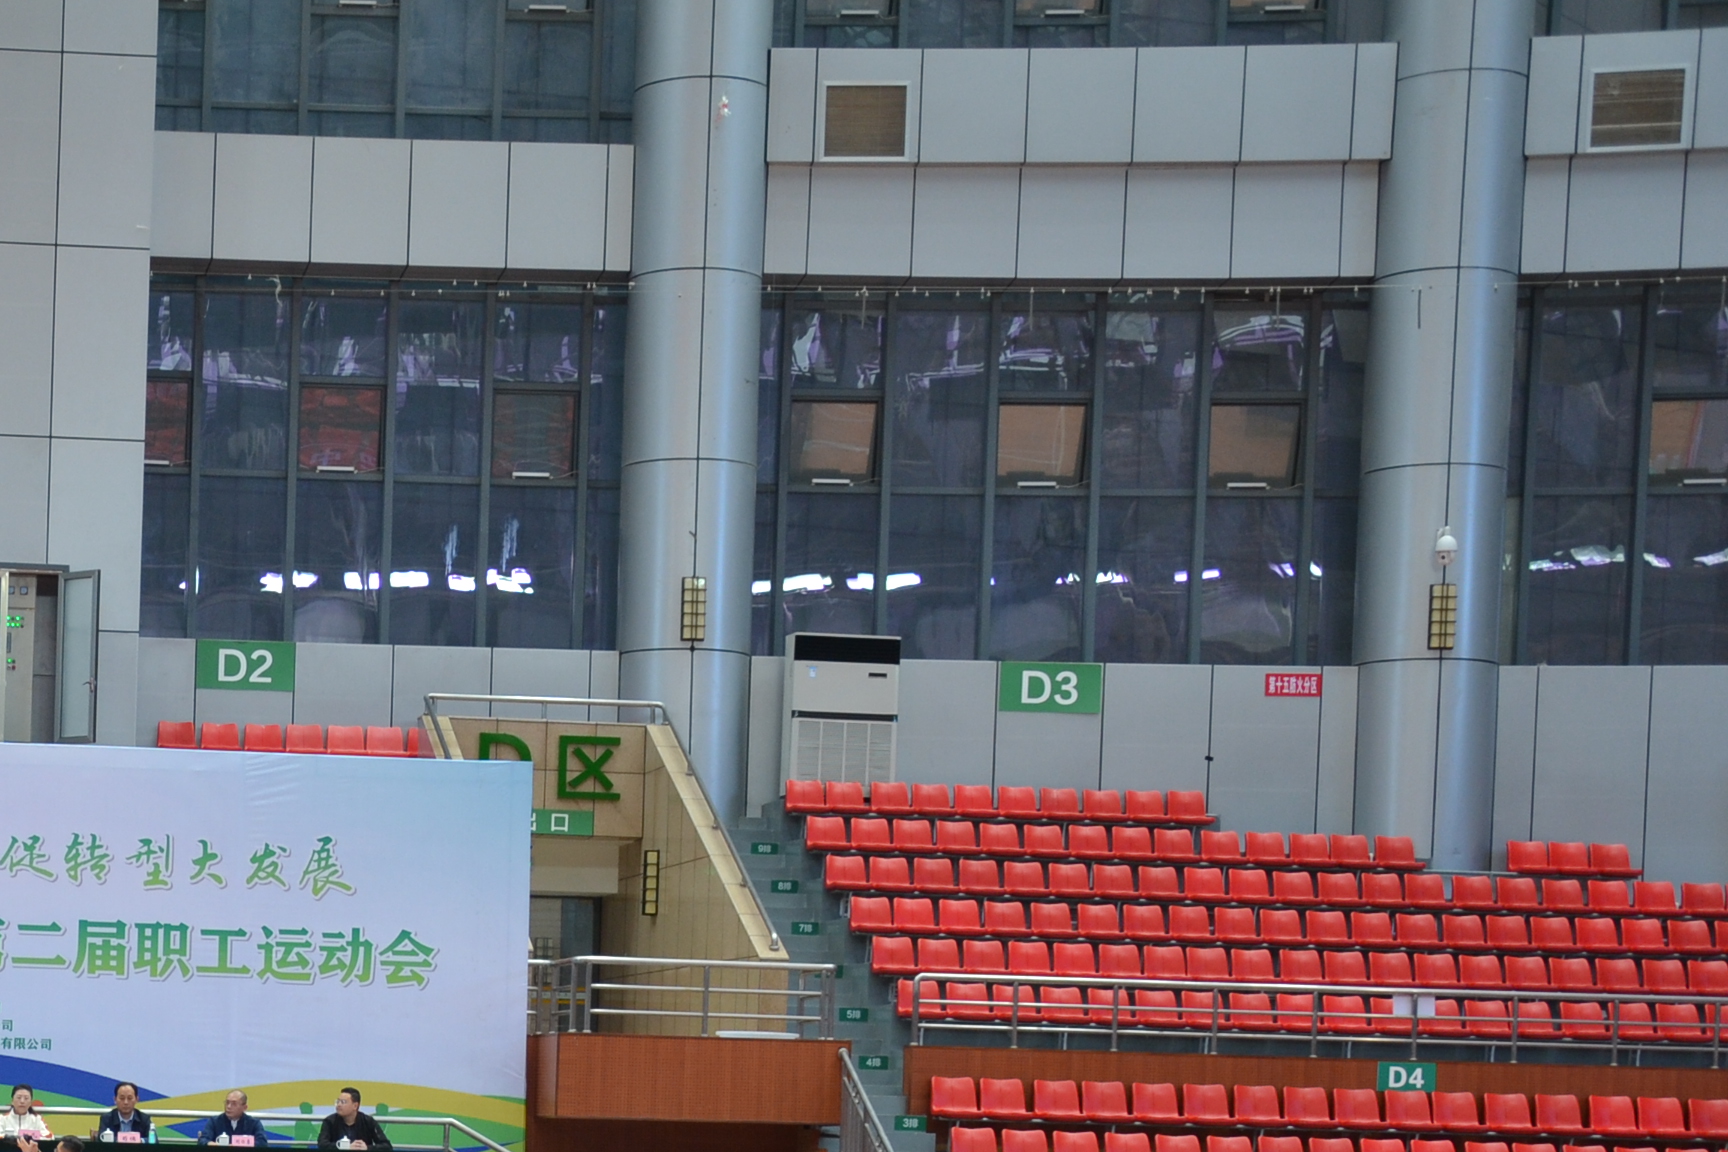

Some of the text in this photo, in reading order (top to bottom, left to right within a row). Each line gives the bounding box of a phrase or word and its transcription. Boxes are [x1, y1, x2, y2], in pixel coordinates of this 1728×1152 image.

[218, 648, 273, 683] D2
[1021, 670, 1079, 705] D3
[1388, 1066, 1425, 1089] D4
